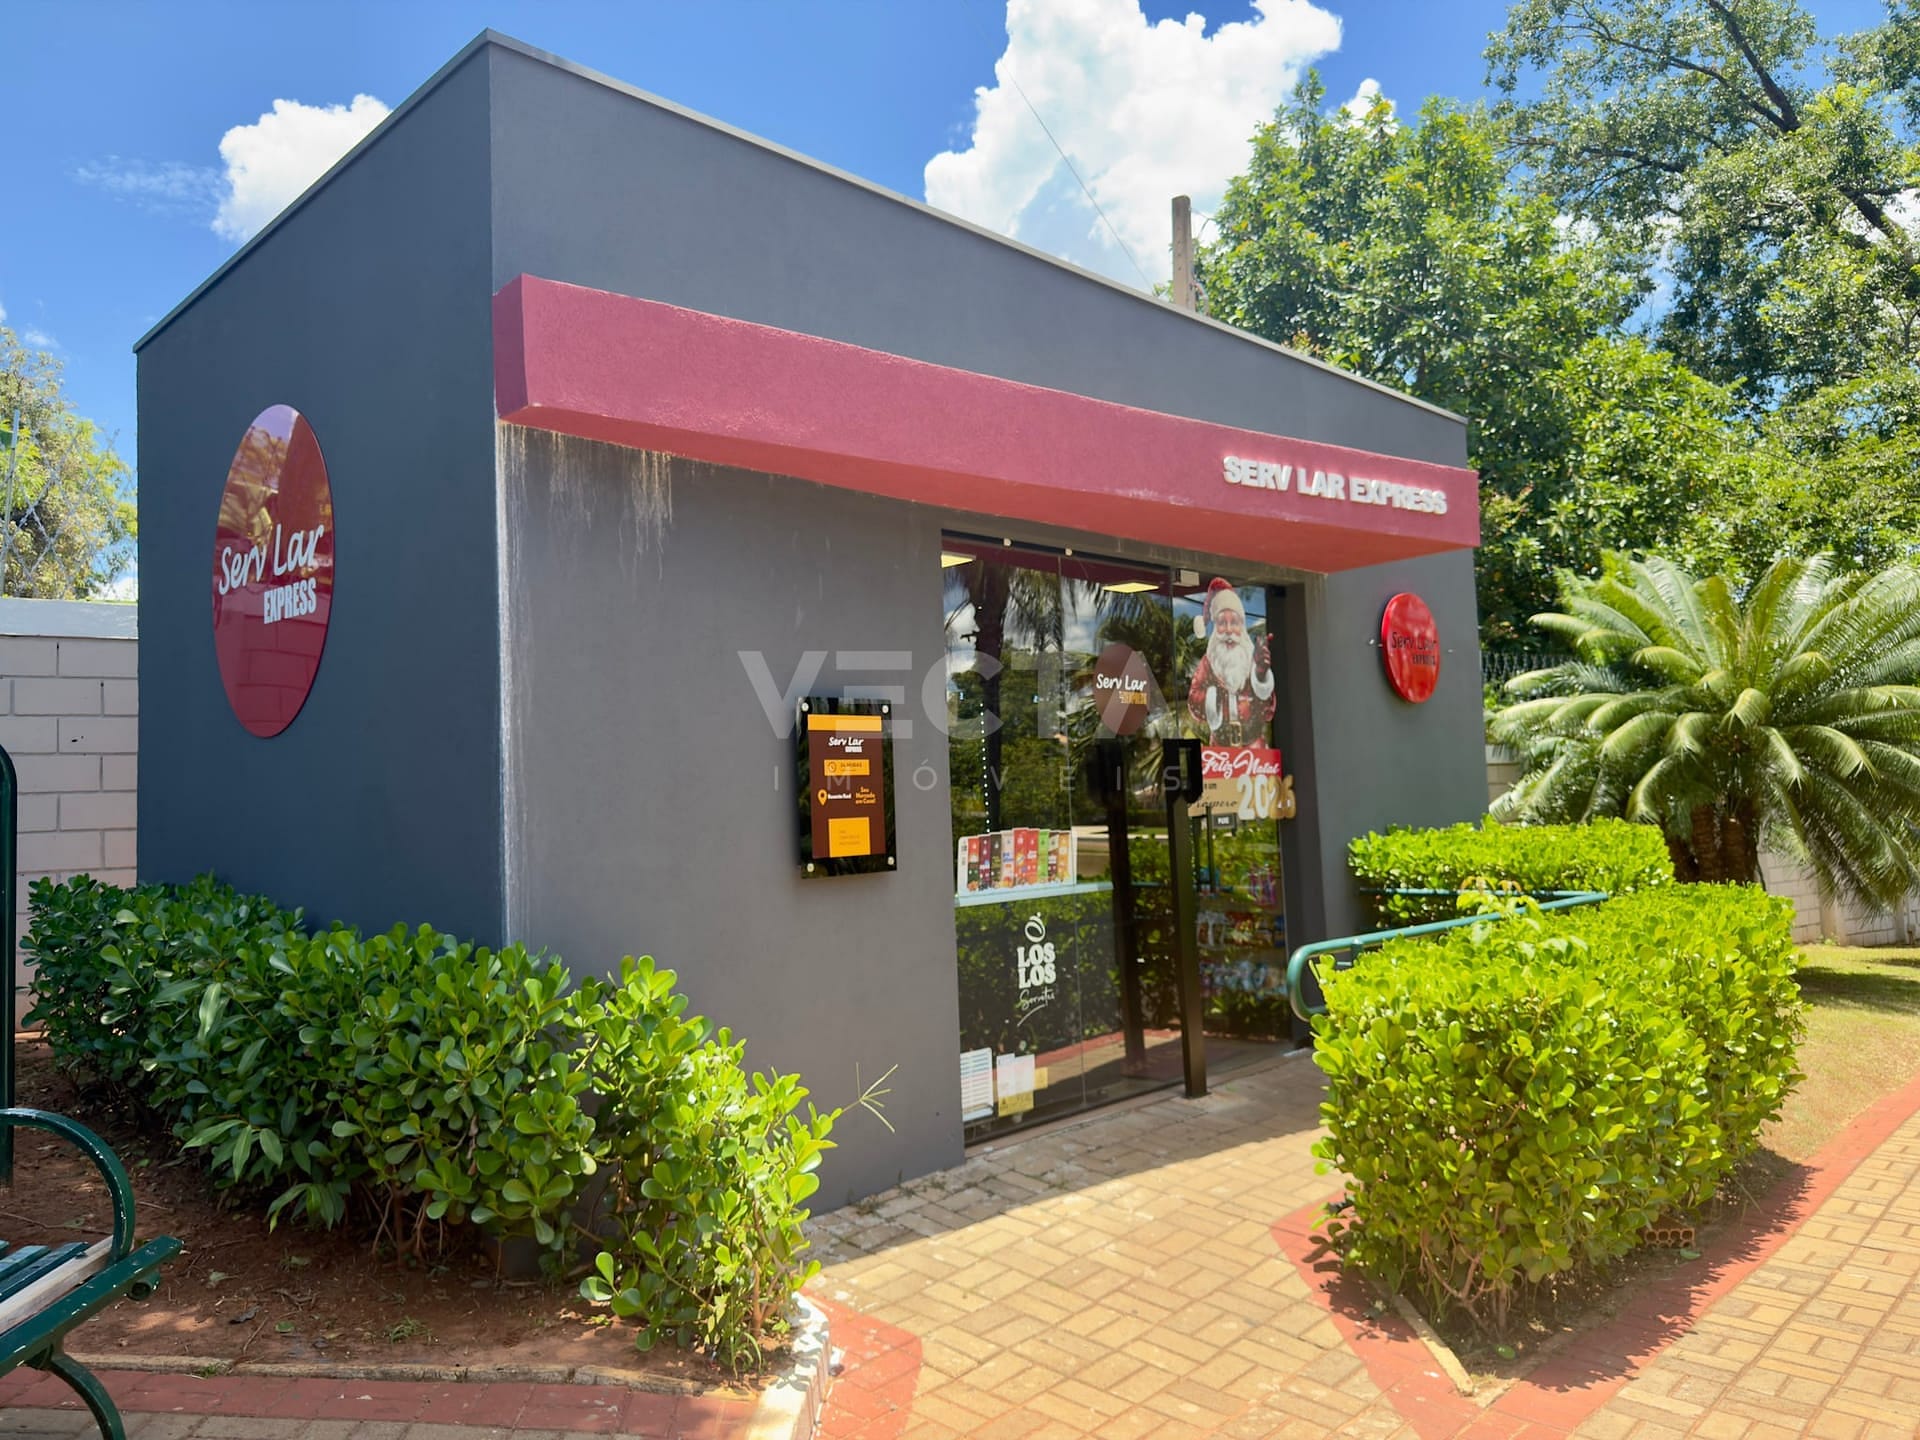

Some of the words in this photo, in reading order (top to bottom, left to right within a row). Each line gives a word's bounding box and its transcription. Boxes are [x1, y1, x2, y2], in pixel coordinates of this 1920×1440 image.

[1223, 455, 1292, 491] SERV
[1297, 467, 1345, 500] LAR
[1349, 477, 1448, 515] EXPRESS
[218, 543, 267, 596] Serv
[273, 523, 325, 577] Lar
[263, 577, 317, 625] EXPRESS
[1391, 631, 1414, 649] Serv
[1096, 673, 1122, 690] Serv
[1124, 674, 1147, 691] Lar
[828, 736, 847, 747] Serv
[847, 736, 864, 746] Lar
[1201, 750, 1234, 779] Feliz
[1233, 749, 1280, 776] Natal
[1237, 774, 1297, 821] 2026
[1017, 942, 1056, 968] LOS
[1018, 963, 1057, 989] LOS
